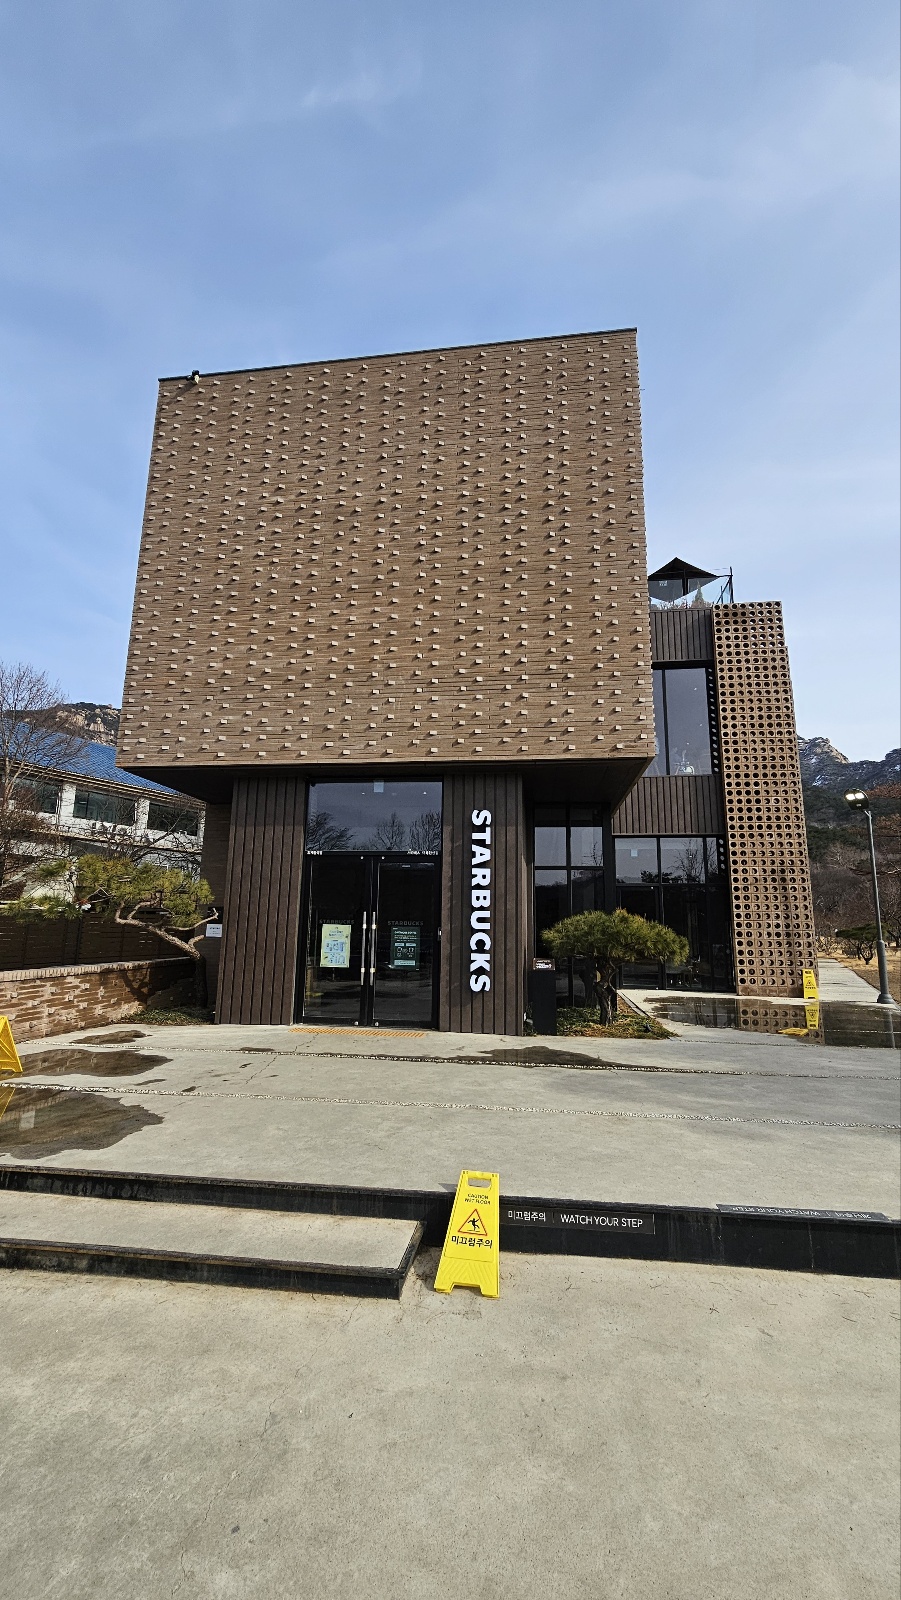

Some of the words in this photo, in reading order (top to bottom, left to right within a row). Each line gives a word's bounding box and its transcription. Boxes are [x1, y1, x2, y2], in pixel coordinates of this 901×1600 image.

[469, 809, 492, 992] STARBUCKS
[507, 1210, 546, 1222] 미끄럼주의
[560, 1213, 593, 1225] WATCH
[594, 1215, 620, 1227] YOUR
[621, 1217, 644, 1228] STEP
[451, 1235, 493, 1249] 미끄럼주의
